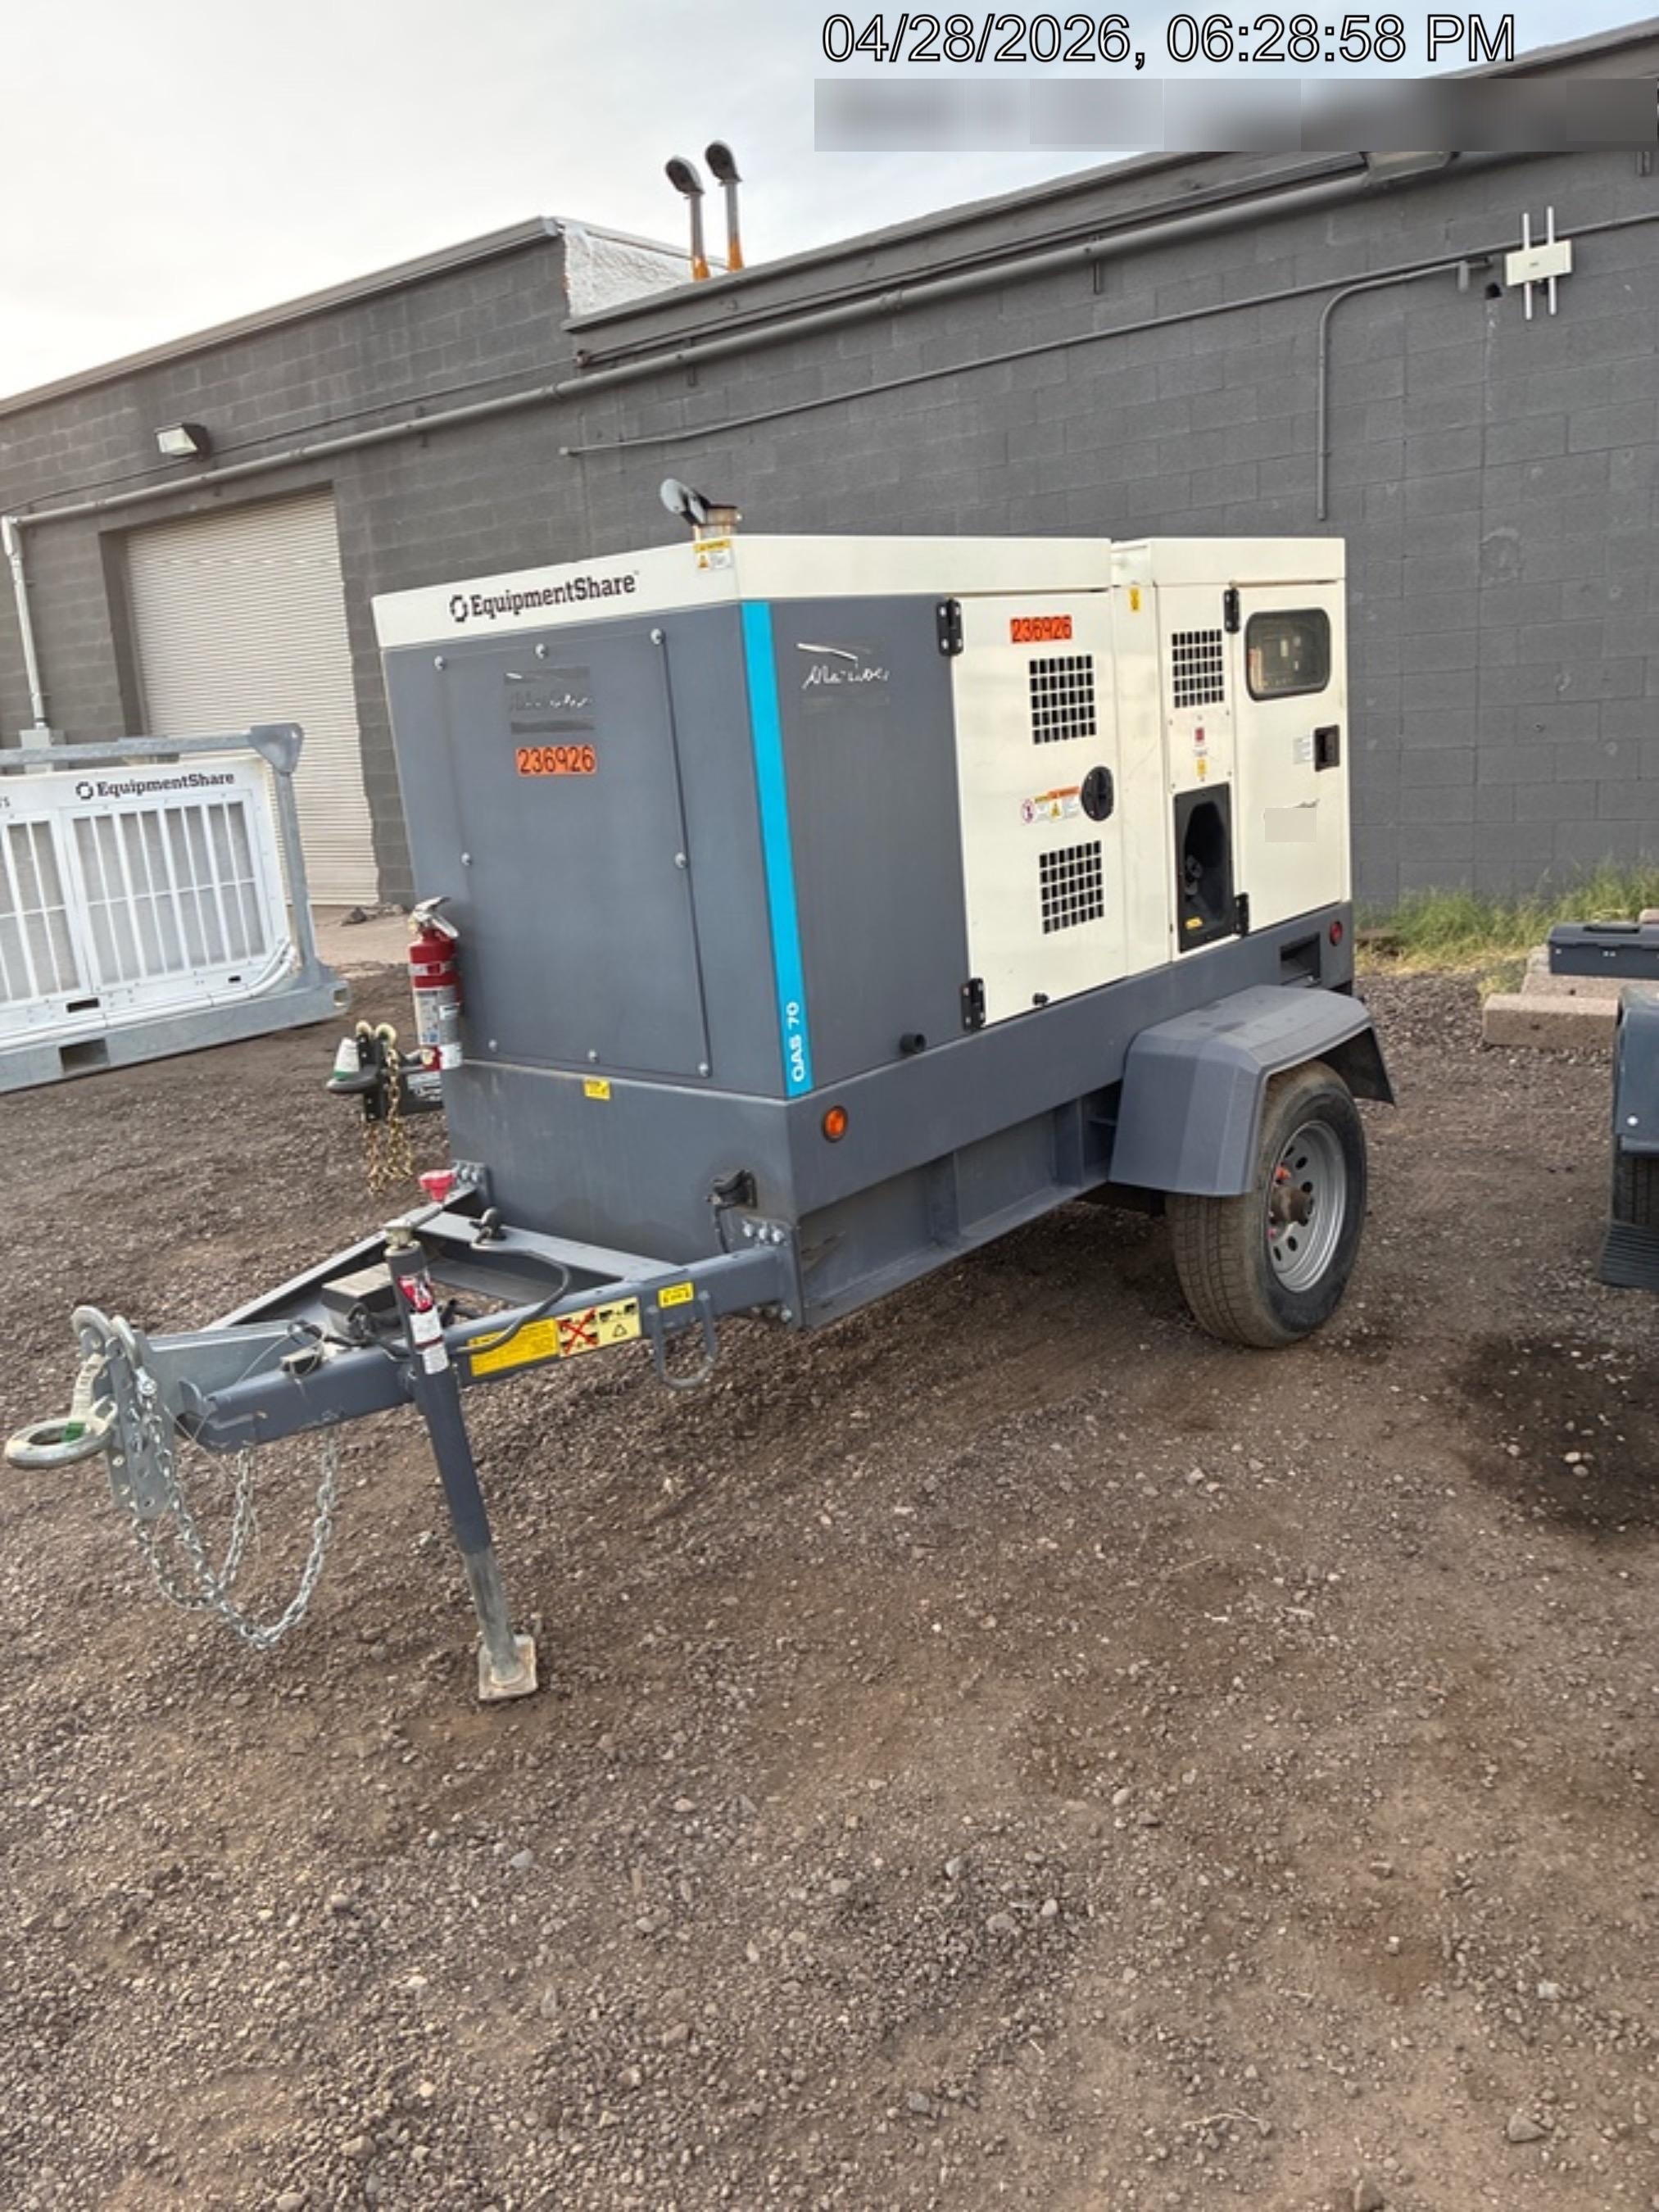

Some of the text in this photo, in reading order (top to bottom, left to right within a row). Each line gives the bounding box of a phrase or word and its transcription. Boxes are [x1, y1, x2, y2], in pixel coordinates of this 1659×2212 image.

[470, 574, 636, 619] EquipmentShare
[518, 745, 595, 773] 236926
[97, 773, 235, 797] EquipmentShare
[786, 1001, 800, 1030] 70
